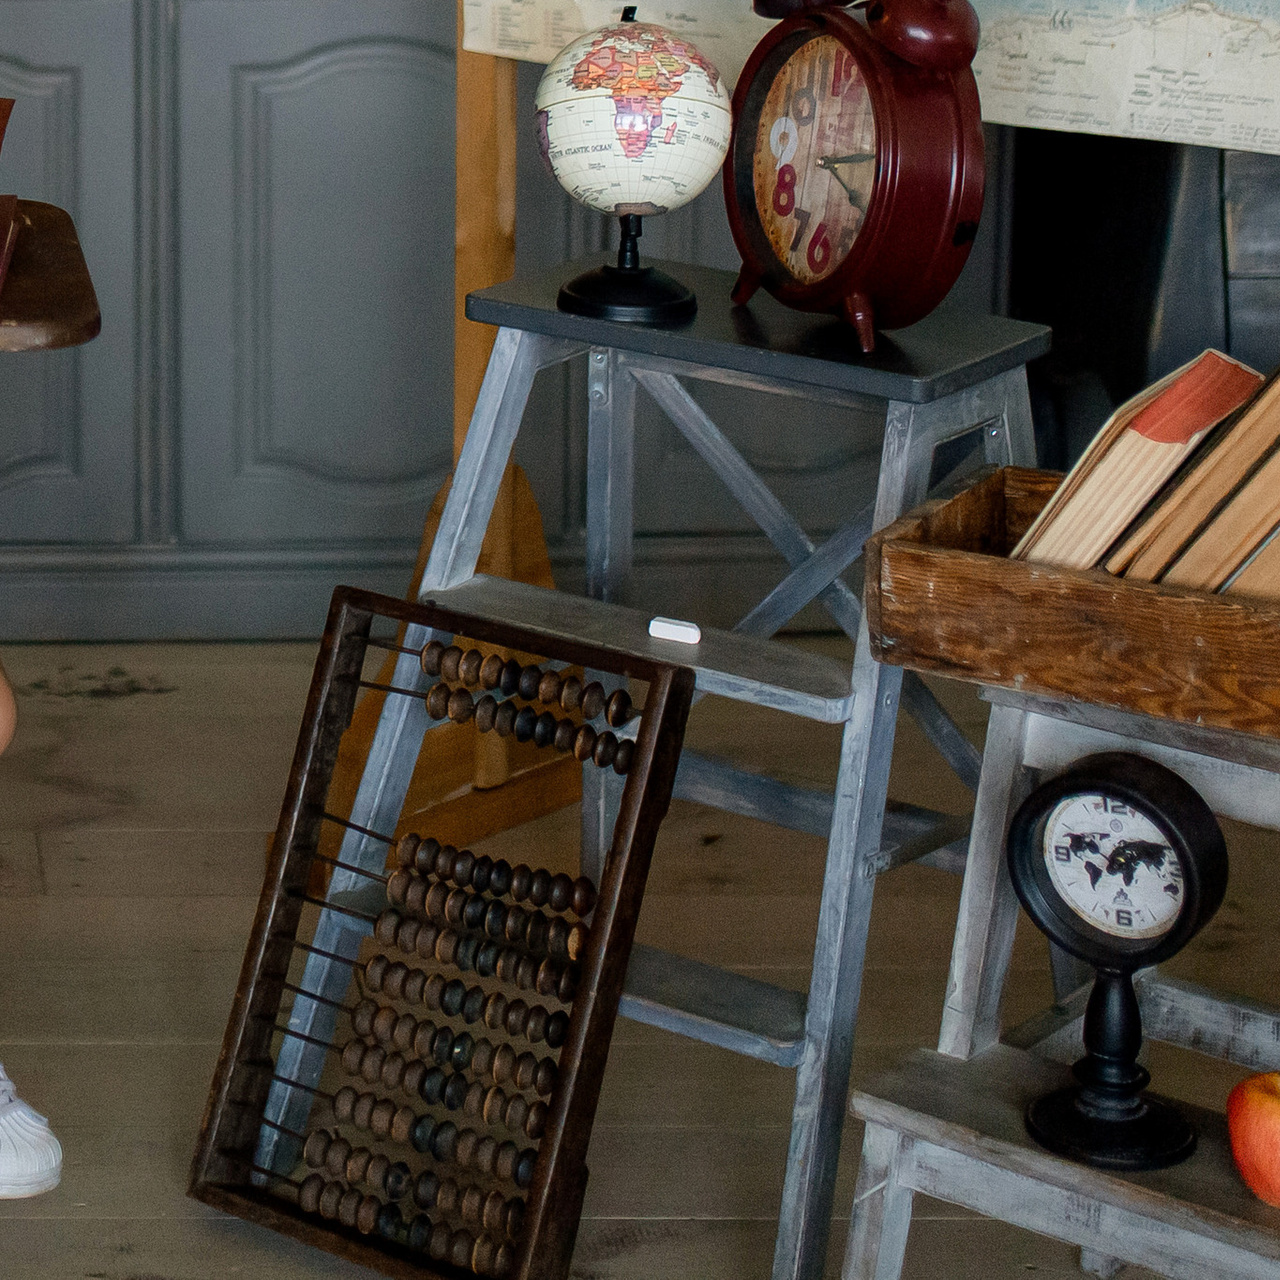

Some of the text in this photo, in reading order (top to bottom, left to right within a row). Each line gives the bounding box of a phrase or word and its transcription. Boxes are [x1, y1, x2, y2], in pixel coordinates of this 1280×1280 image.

[769, 116, 799, 170] 9
[772, 163, 797, 217] 8
[790, 207, 812, 253] 7
[807, 221, 831, 275] 6
[1054, 845, 1071, 862] 9
[1115, 908, 1133, 927] 6
